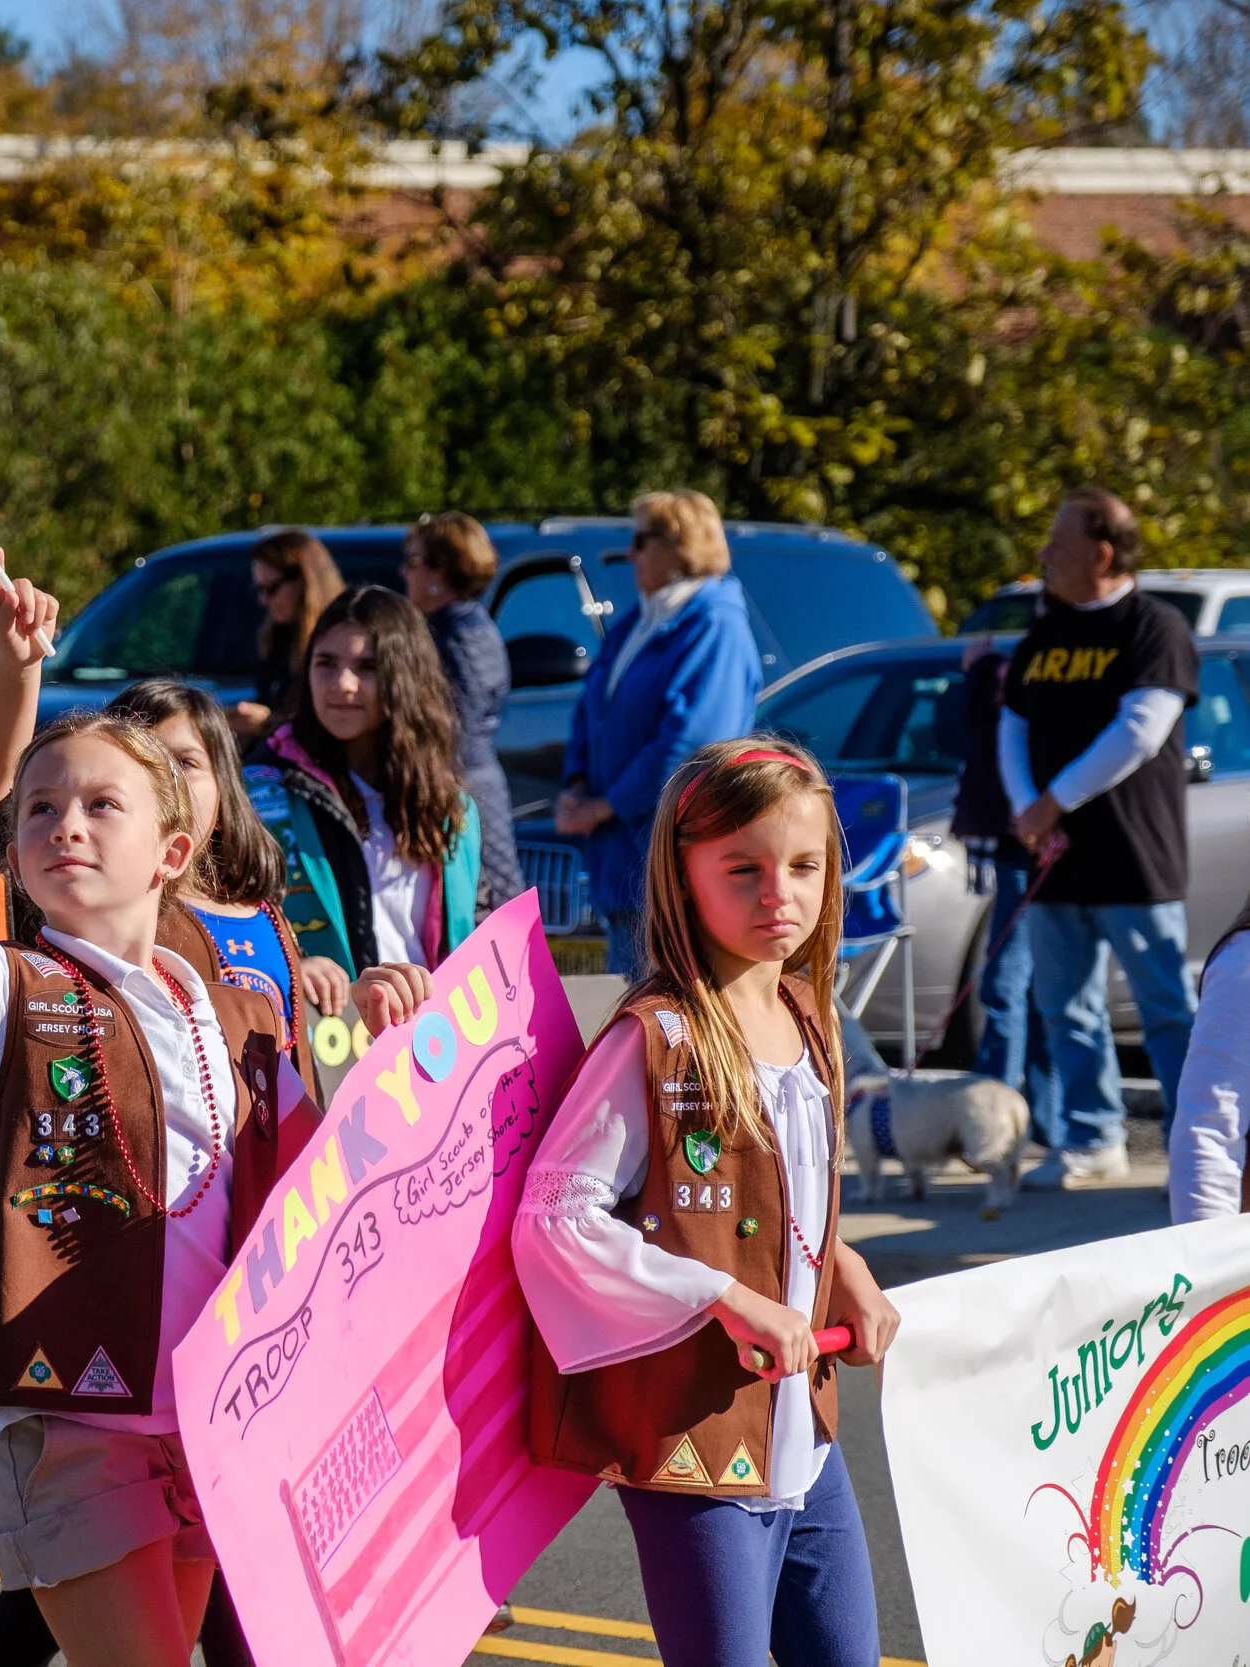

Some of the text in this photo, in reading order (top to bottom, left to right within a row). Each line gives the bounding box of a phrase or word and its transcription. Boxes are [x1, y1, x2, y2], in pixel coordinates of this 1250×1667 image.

[1022, 648, 1119, 685] ARMY
[28, 1001, 50, 1012] GIRL
[93, 1008, 113, 1018] USA
[35, 1023, 71, 1034] JERSEY
[663, 1082, 683, 1093] GIRL
[671, 1101, 700, 1112] JERSEY
[37, 1113, 100, 1137] 343
[407, 1166, 434, 1205] Girl
[439, 1122, 473, 1170] Scouts
[501, 1067, 522, 1092] the
[440, 1101, 519, 1195] Jersey Shore!
[677, 1184, 732, 1209] 343
[215, 1095, 388, 1347] THANK
[224, 1211, 381, 1421] TROOP 343
[1031, 1273, 1192, 1451] Juniors
